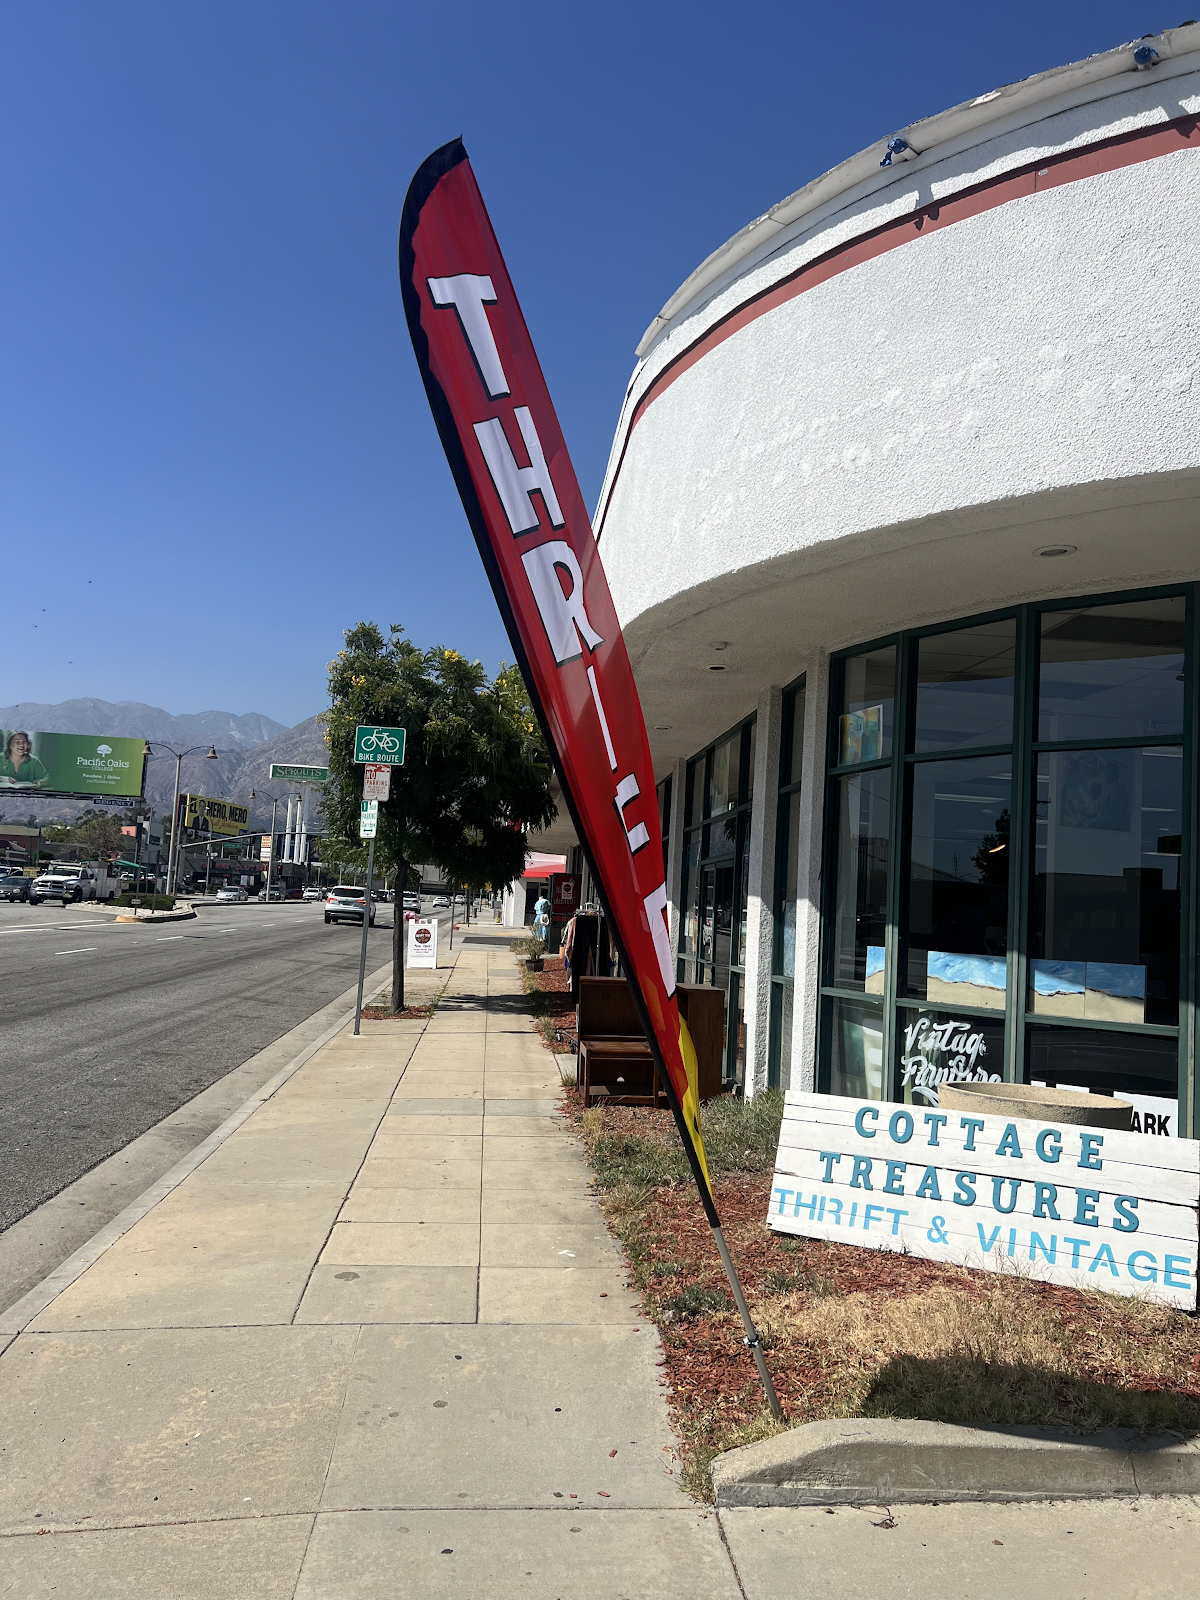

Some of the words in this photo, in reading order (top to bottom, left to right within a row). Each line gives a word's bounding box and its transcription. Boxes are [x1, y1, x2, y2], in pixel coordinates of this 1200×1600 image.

[76, 757, 106, 766] Pacific
[107, 759, 130, 768] Oaks
[358, 752, 374, 761] BIKE
[376, 753, 399, 763] ROUTE
[276, 766, 322, 777] SPROUTS
[366, 770, 375, 779] NO
[366, 779, 388, 787] PARKING
[189, 797, 198, 814] EL
[228, 805, 248, 824] MERO
[1131, 1111, 1171, 1138] ARK
[854, 1106, 1104, 1171] COTTAGE
[819, 1150, 1140, 1233] TREASURES
[773, 1187, 909, 1236] THRIFT
[926, 1214, 950, 1245] &
[975, 1221, 1193, 1290] VINTAGE
